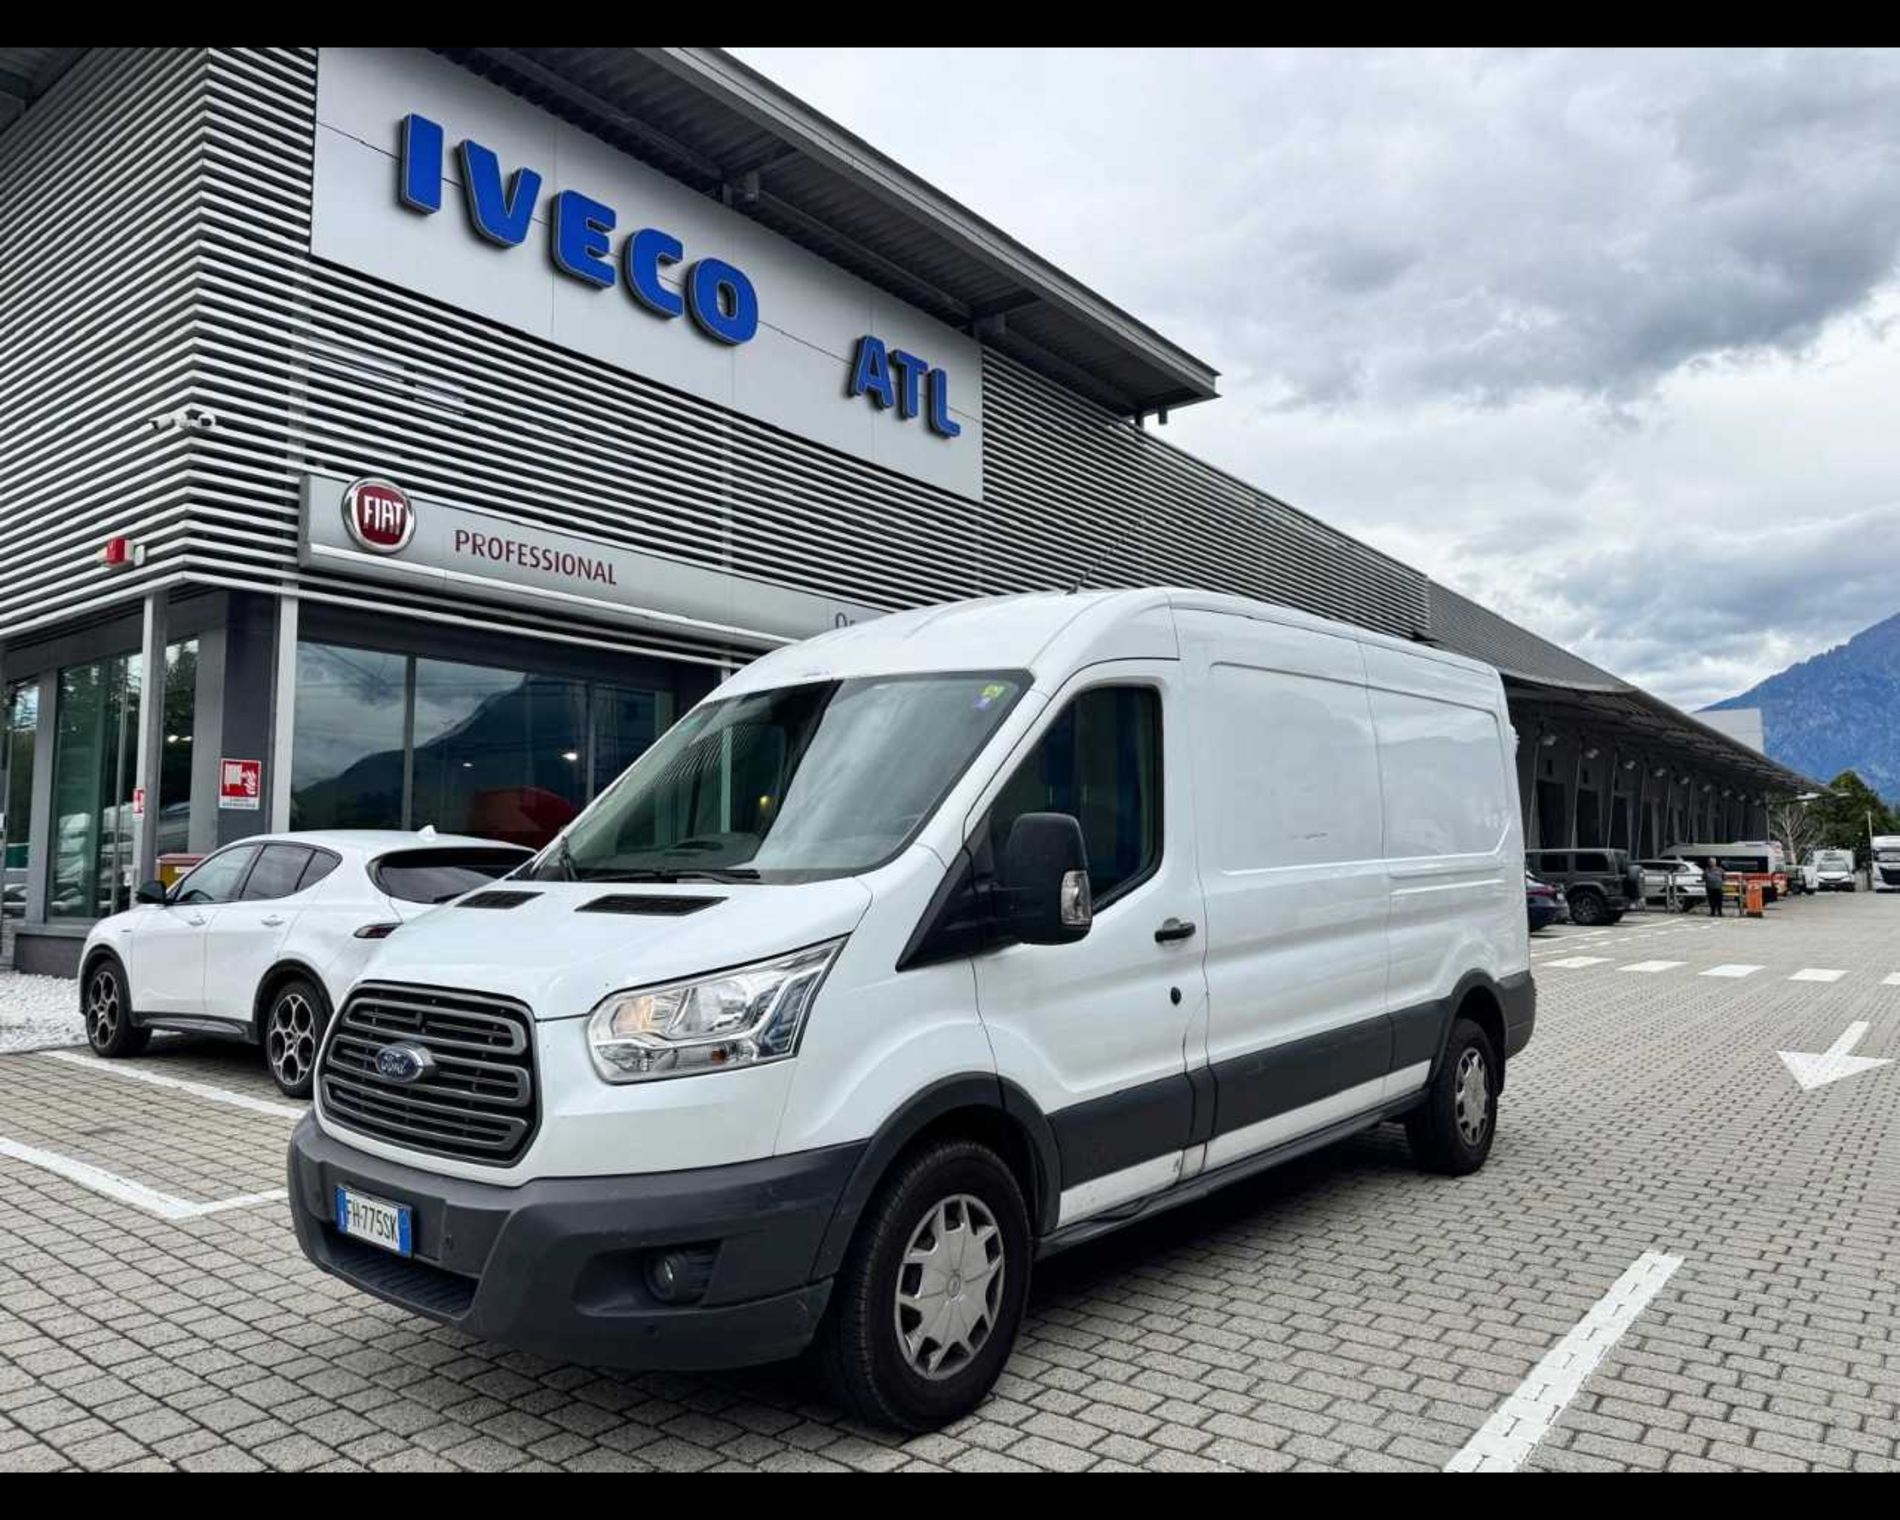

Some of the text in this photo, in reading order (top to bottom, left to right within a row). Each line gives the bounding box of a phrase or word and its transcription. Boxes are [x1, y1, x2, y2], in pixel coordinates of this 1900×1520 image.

[400, 112, 960, 439] IVECO ATL
[363, 494, 404, 536] FIAT
[454, 528, 617, 586] PROFESSIONAL
